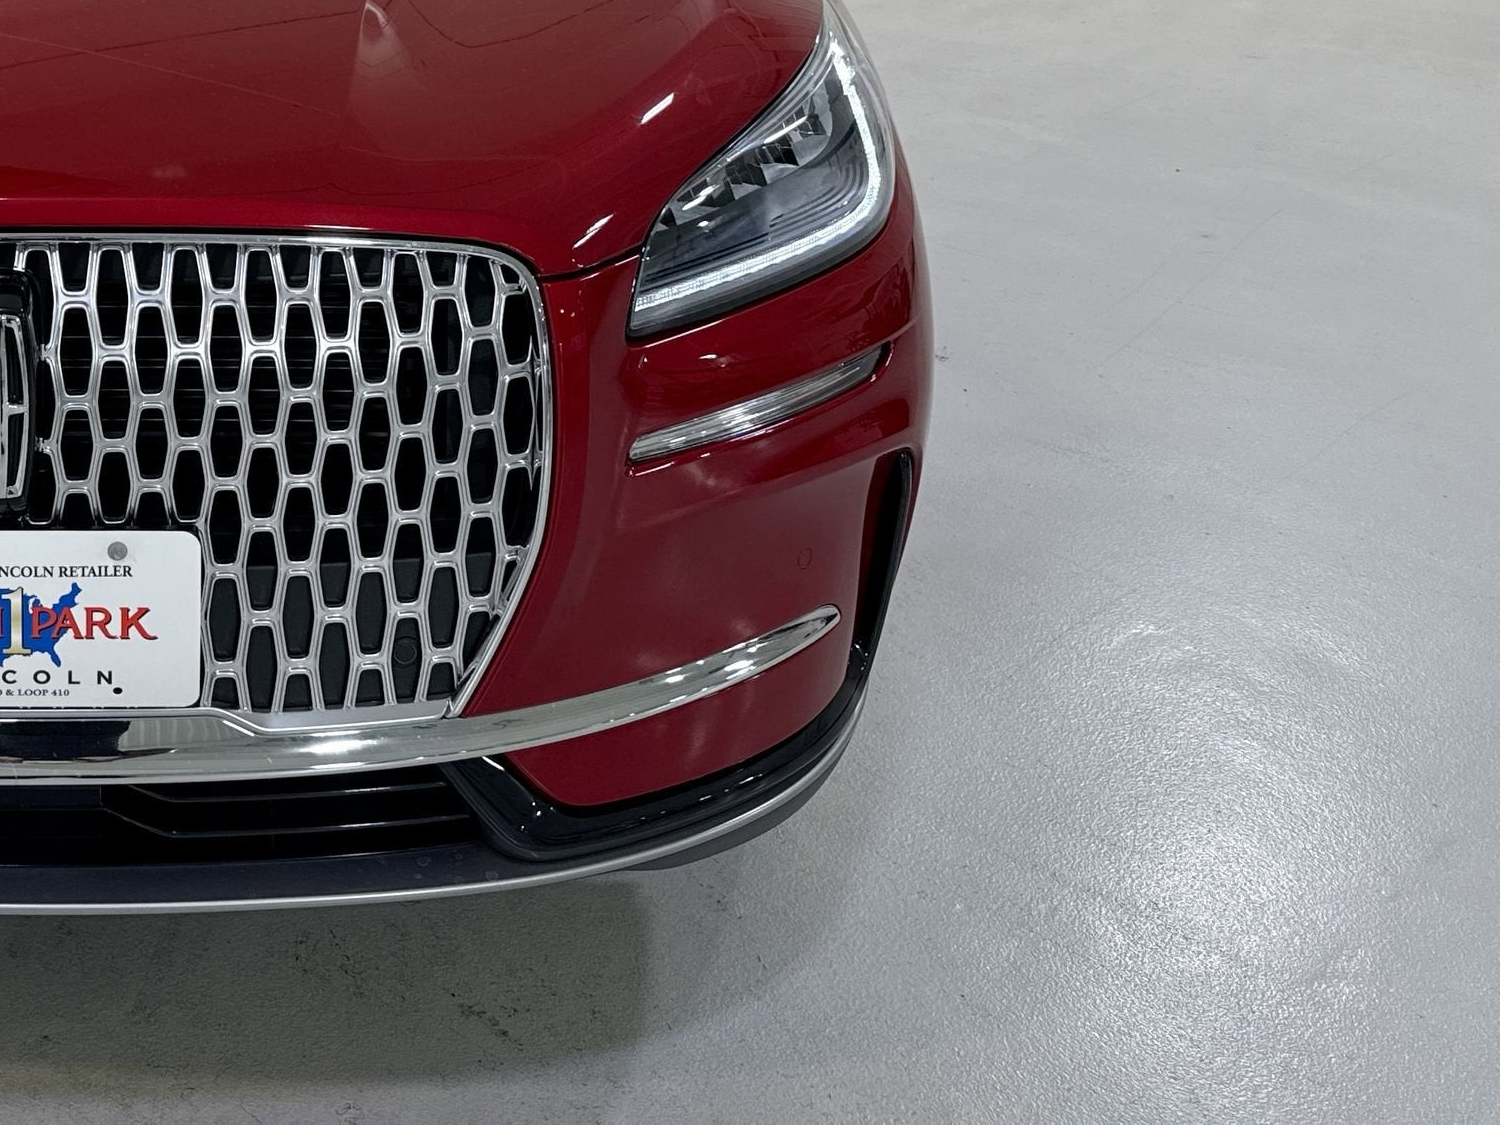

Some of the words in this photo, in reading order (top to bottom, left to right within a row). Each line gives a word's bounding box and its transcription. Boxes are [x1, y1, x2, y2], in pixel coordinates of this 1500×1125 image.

[58, 565, 133, 578] RETAILER
[29, 606, 159, 641] PARK
[5, 688, 15, 697] &
[17, 688, 50, 697] LOOP
[51, 688, 71, 697] 410
